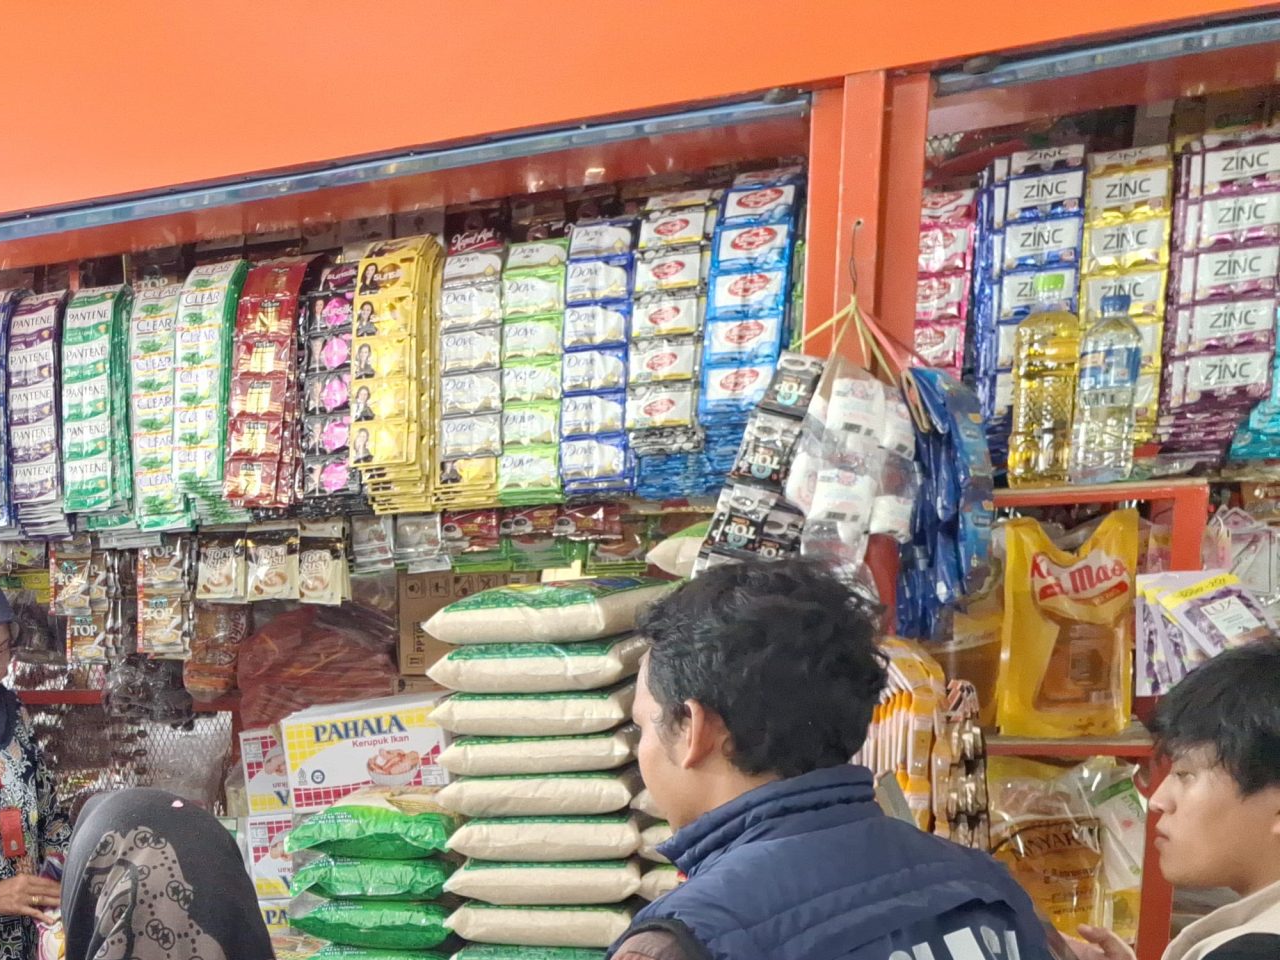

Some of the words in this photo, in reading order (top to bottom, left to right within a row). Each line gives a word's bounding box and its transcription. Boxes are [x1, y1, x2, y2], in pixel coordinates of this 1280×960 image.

[1222, 149, 1269, 172] ZINC
[1024, 178, 1067, 199] ZINC
[1105, 178, 1151, 200] ZINC
[1218, 199, 1266, 224] ZINC
[1020, 226, 1063, 248] ZINC
[1102, 228, 1148, 250] ZINC
[1214, 253, 1262, 276] ZINC
[185, 291, 220, 305] CLEAR
[12, 315, 51, 330] PANTENE
[68, 308, 109, 321] PANTENE
[1209, 304, 1258, 329] ZINC
[136, 318, 172, 332] CLEAR
[10, 351, 49, 367] PANTENE
[66, 345, 106, 360] PANTENE
[1204, 358, 1251, 381] ZINC
[11, 389, 51, 401] PANTENE
[774, 379, 807, 397] TOP
[137, 395, 172, 410] CLEAR
[13, 427, 52, 440] PANTENE
[724, 522, 757, 540] TOP
[70, 624, 98, 636] TOP
[312, 714, 408, 743] PAHALA
[352, 736, 391, 748] Kerupuk
[391, 734, 410, 744] Ikan
